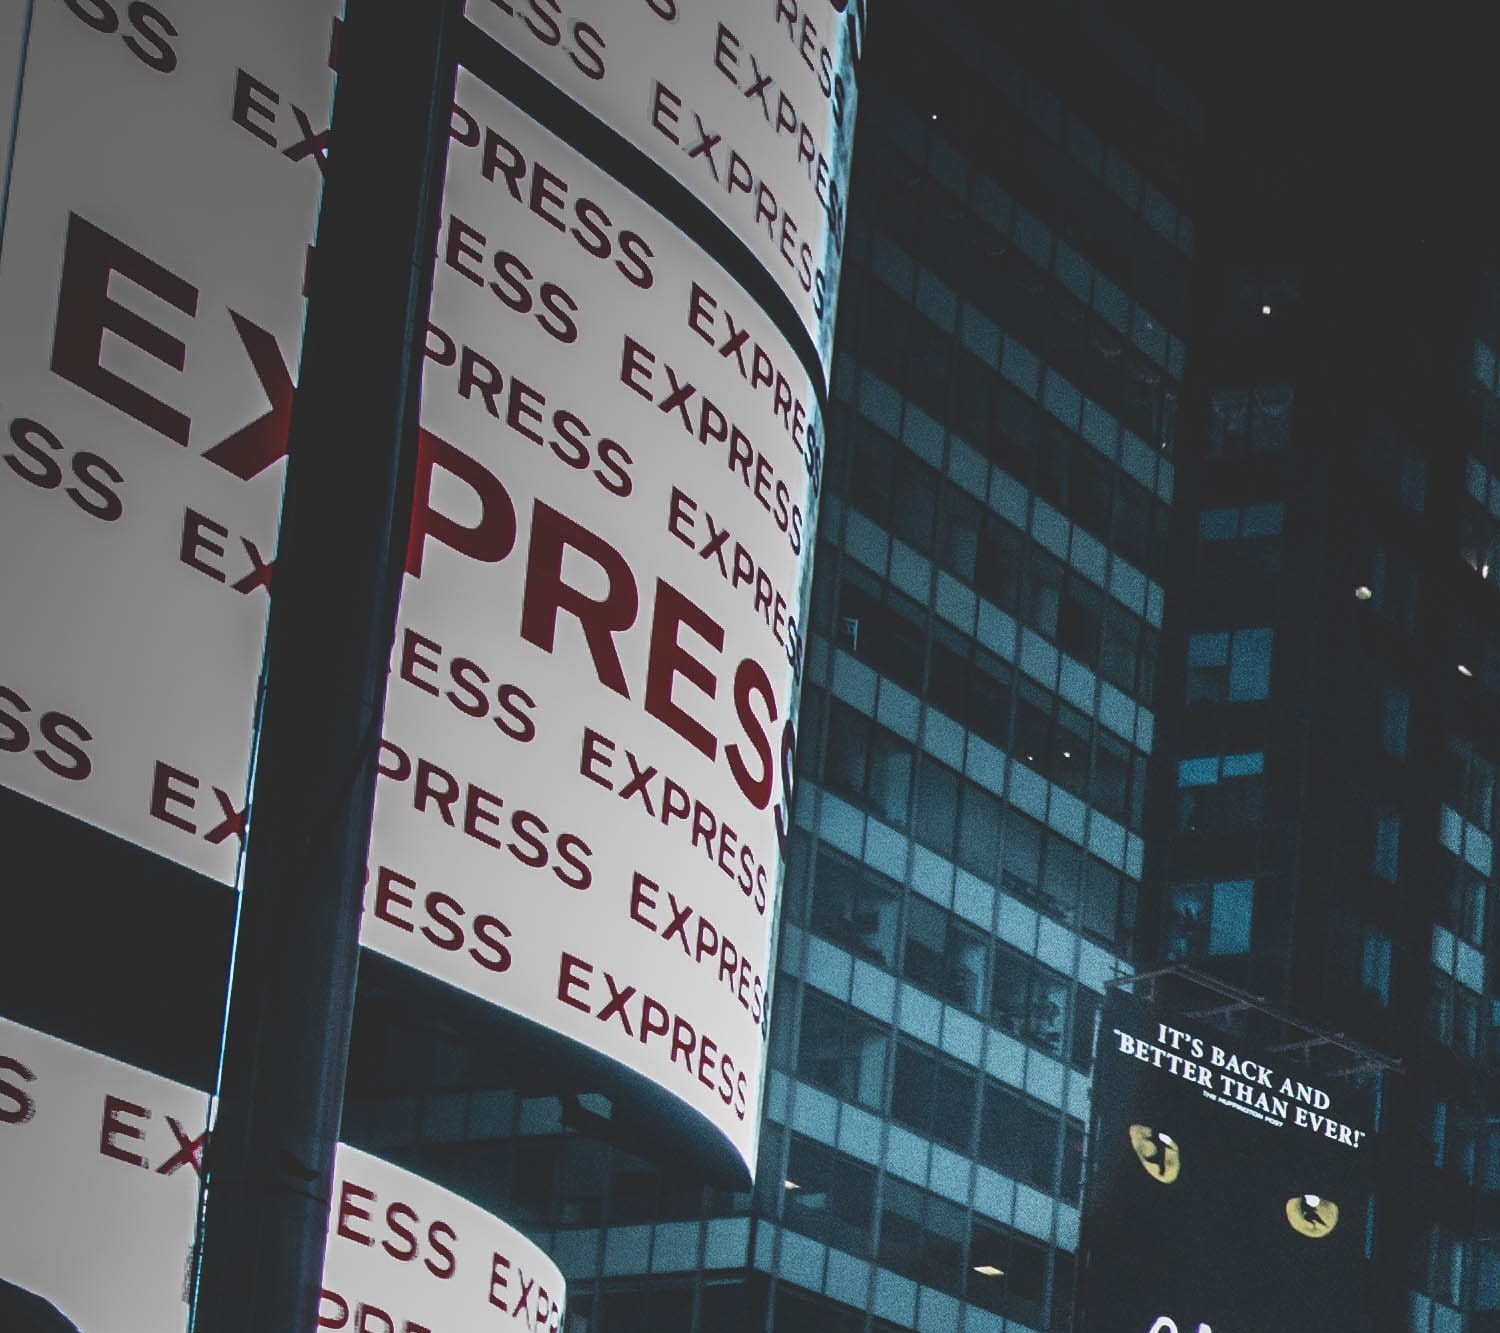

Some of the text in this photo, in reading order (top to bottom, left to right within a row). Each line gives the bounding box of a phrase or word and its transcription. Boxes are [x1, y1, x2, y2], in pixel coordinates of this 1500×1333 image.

[650, 80, 826, 321] EXPRESS
[620, 333, 804, 557] EXPRESS
[687, 280, 828, 500] EXPRESS
[668, 485, 801, 688] EXPRESS
[579, 726, 768, 916] EXPRESS
[556, 951, 748, 1121] EXPRESS
[629, 869, 770, 1041] EXPRESS
[1210, 1045, 1273, 1089] BACK
[1279, 1077, 1331, 1111] AND
[1220, 1074, 1289, 1120] THAN
